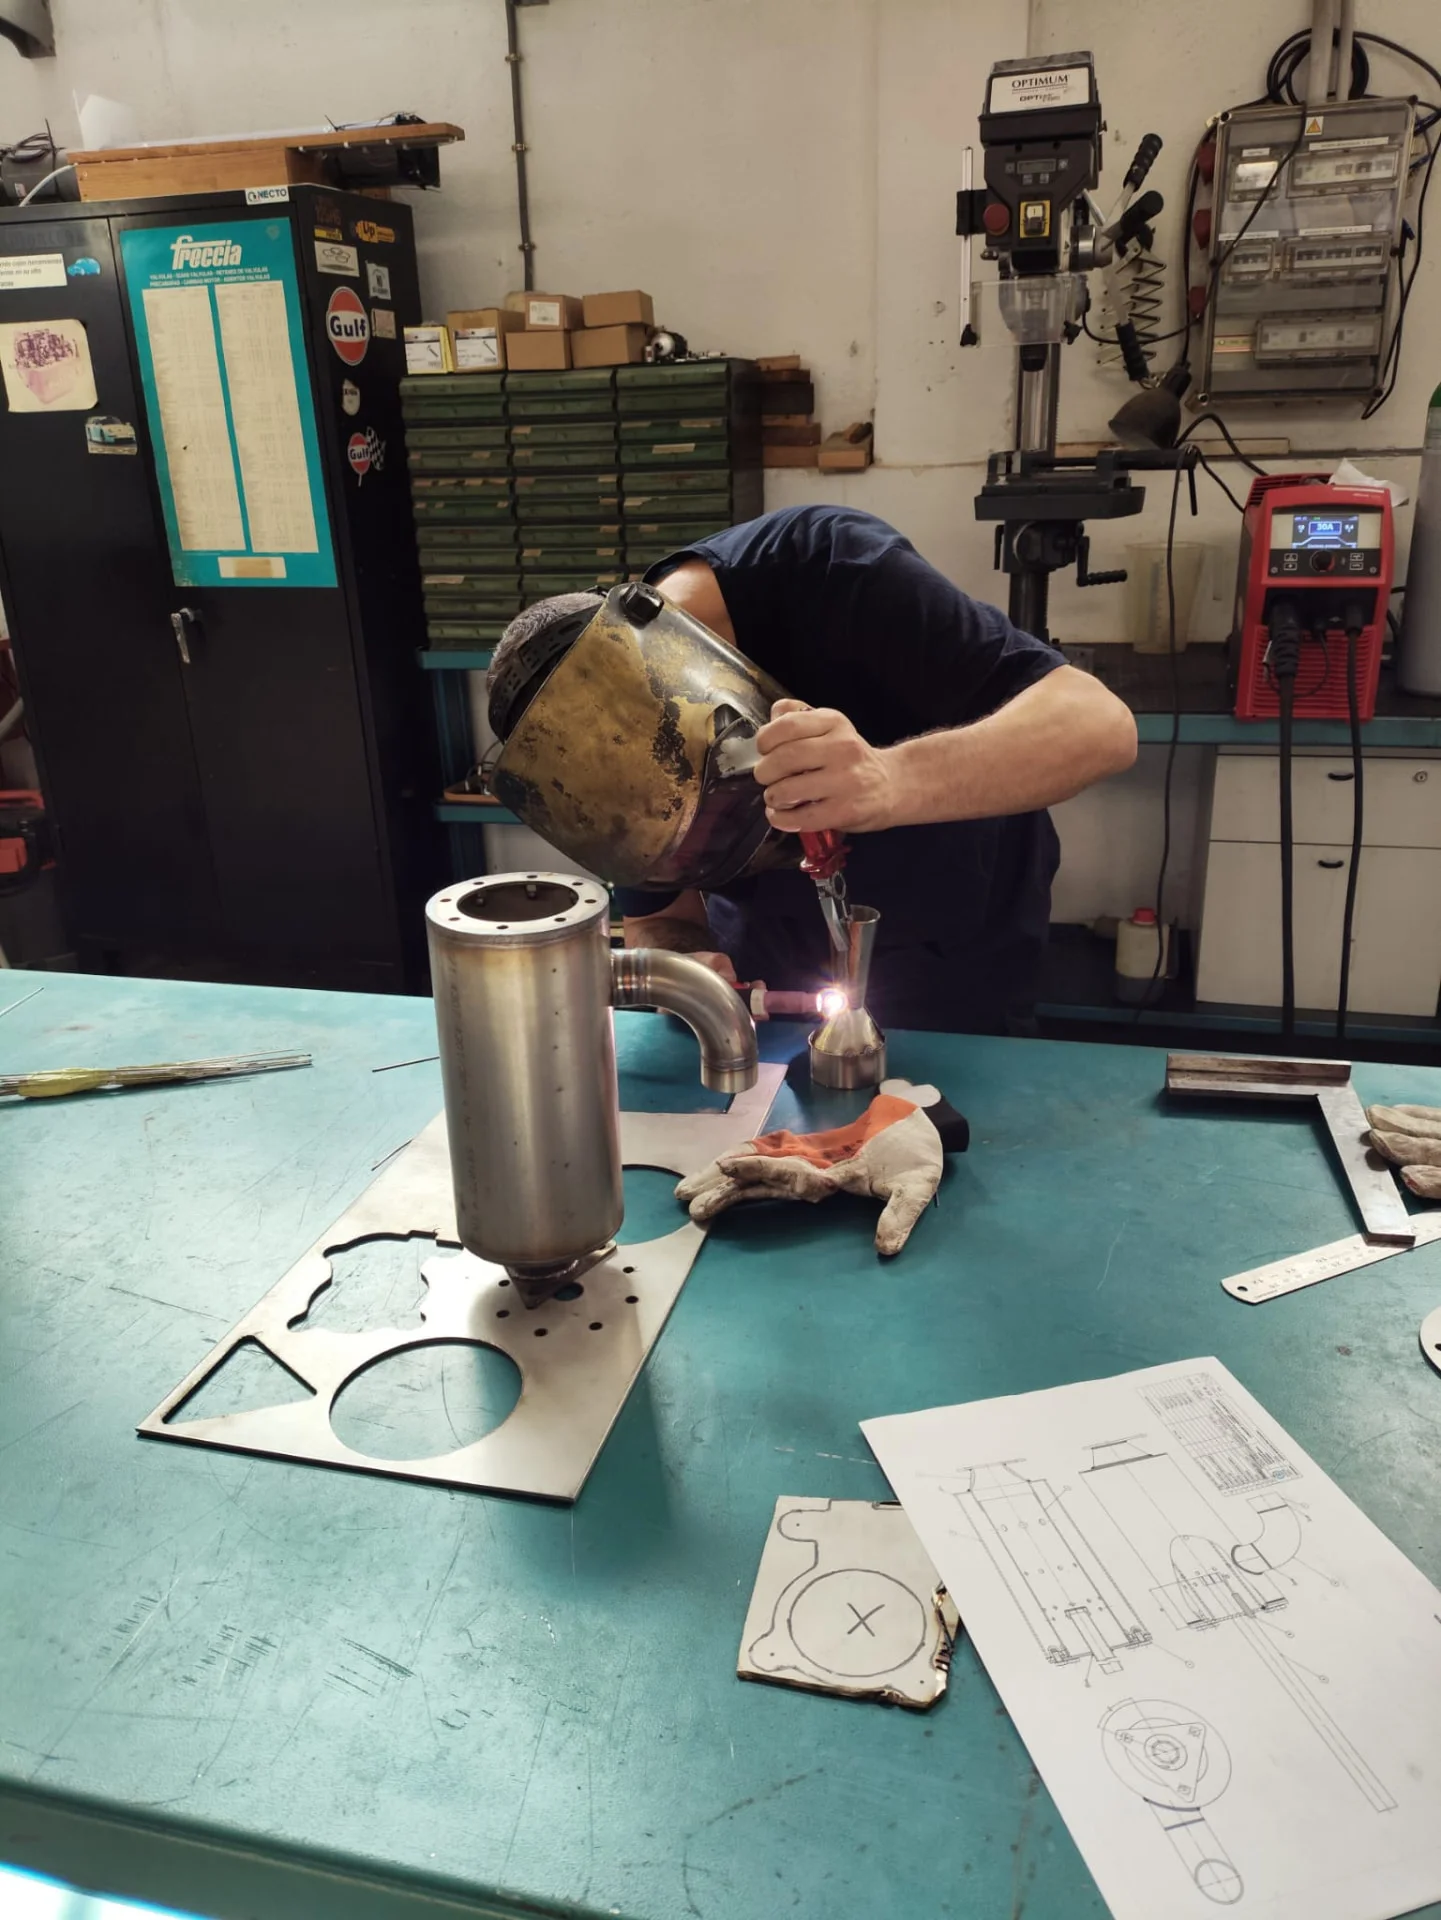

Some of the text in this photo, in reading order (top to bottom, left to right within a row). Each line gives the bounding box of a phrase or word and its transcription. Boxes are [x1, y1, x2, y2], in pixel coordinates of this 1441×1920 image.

[1011, 74, 1068, 89] OPTIMUM
[170, 234, 242, 270] freccia
[330, 315, 366, 337] Gulf
[349, 447, 369, 460] Gulf
